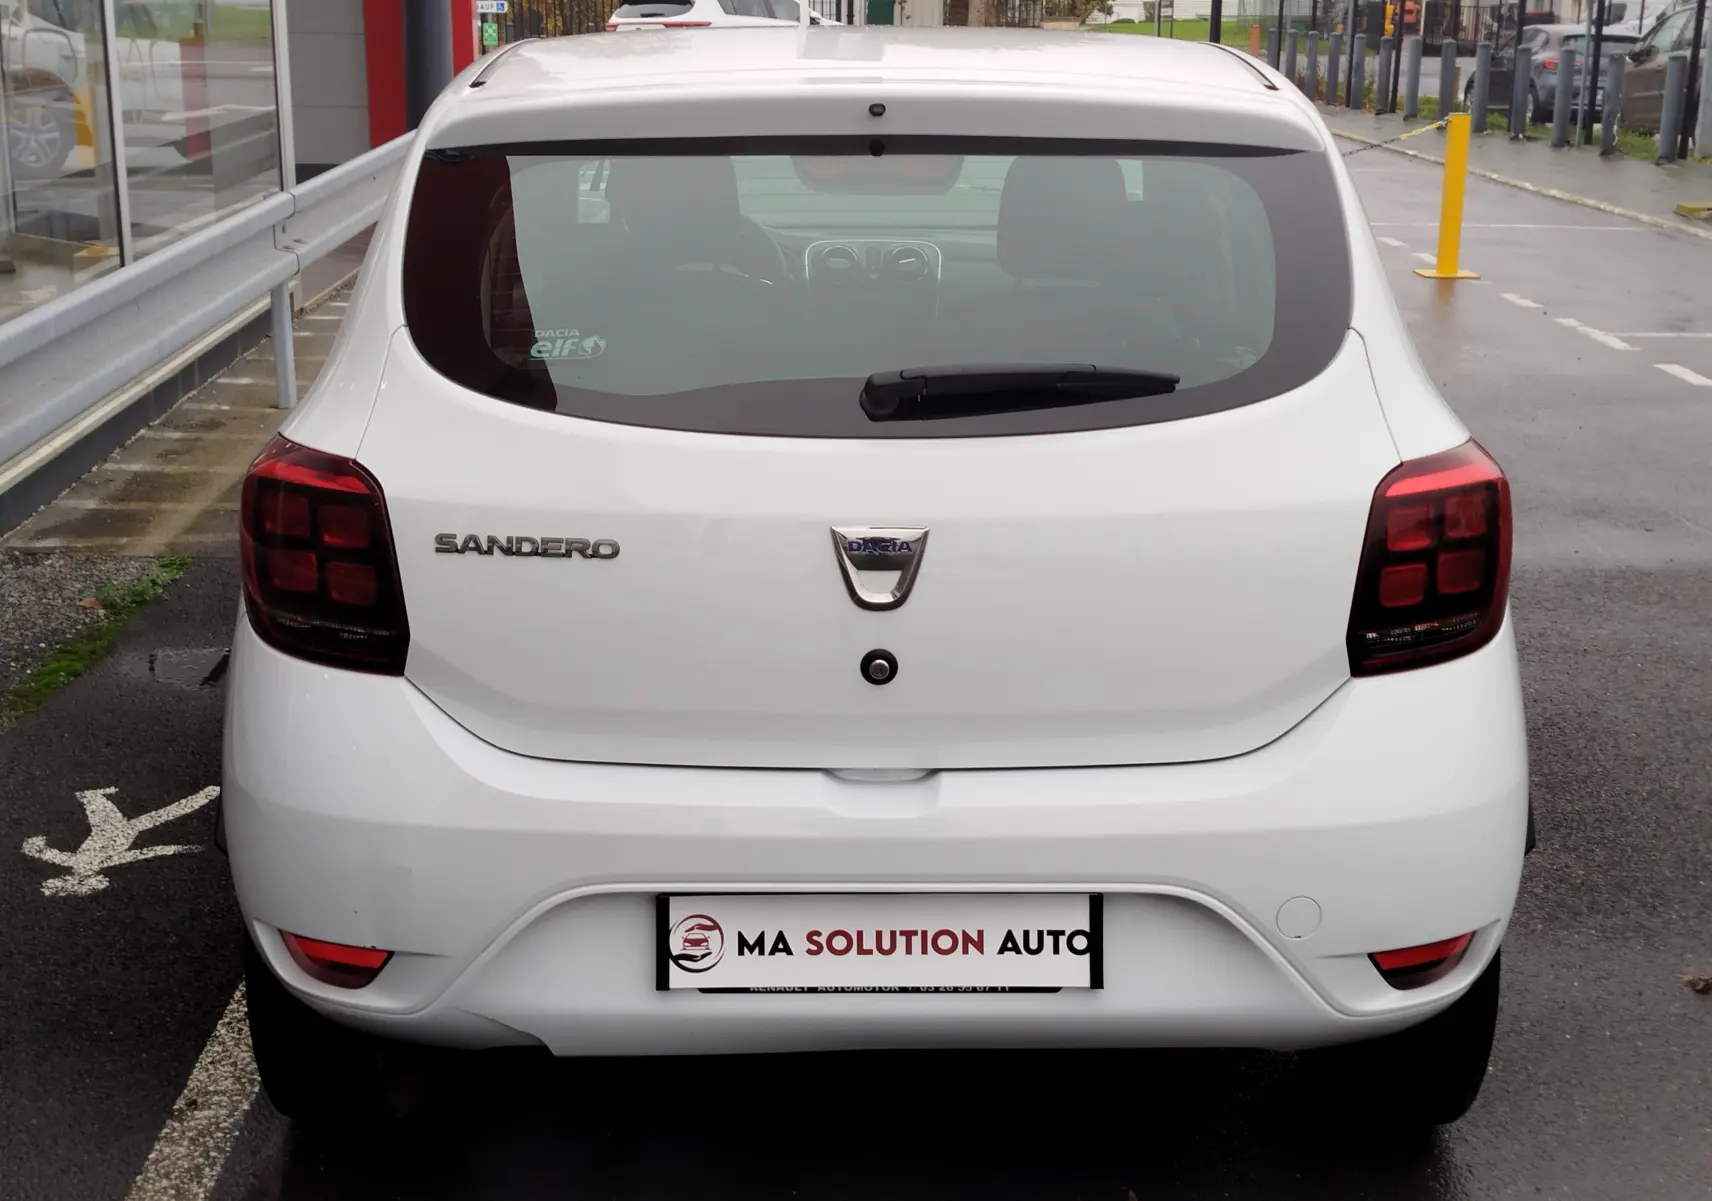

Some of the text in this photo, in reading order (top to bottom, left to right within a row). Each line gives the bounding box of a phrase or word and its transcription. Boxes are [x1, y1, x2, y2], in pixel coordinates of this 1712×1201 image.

[535, 328, 580, 338] DACIA
[530, 338, 580, 358] elf
[434, 532, 621, 560] SANDERO
[847, 540, 913, 554] DACIA
